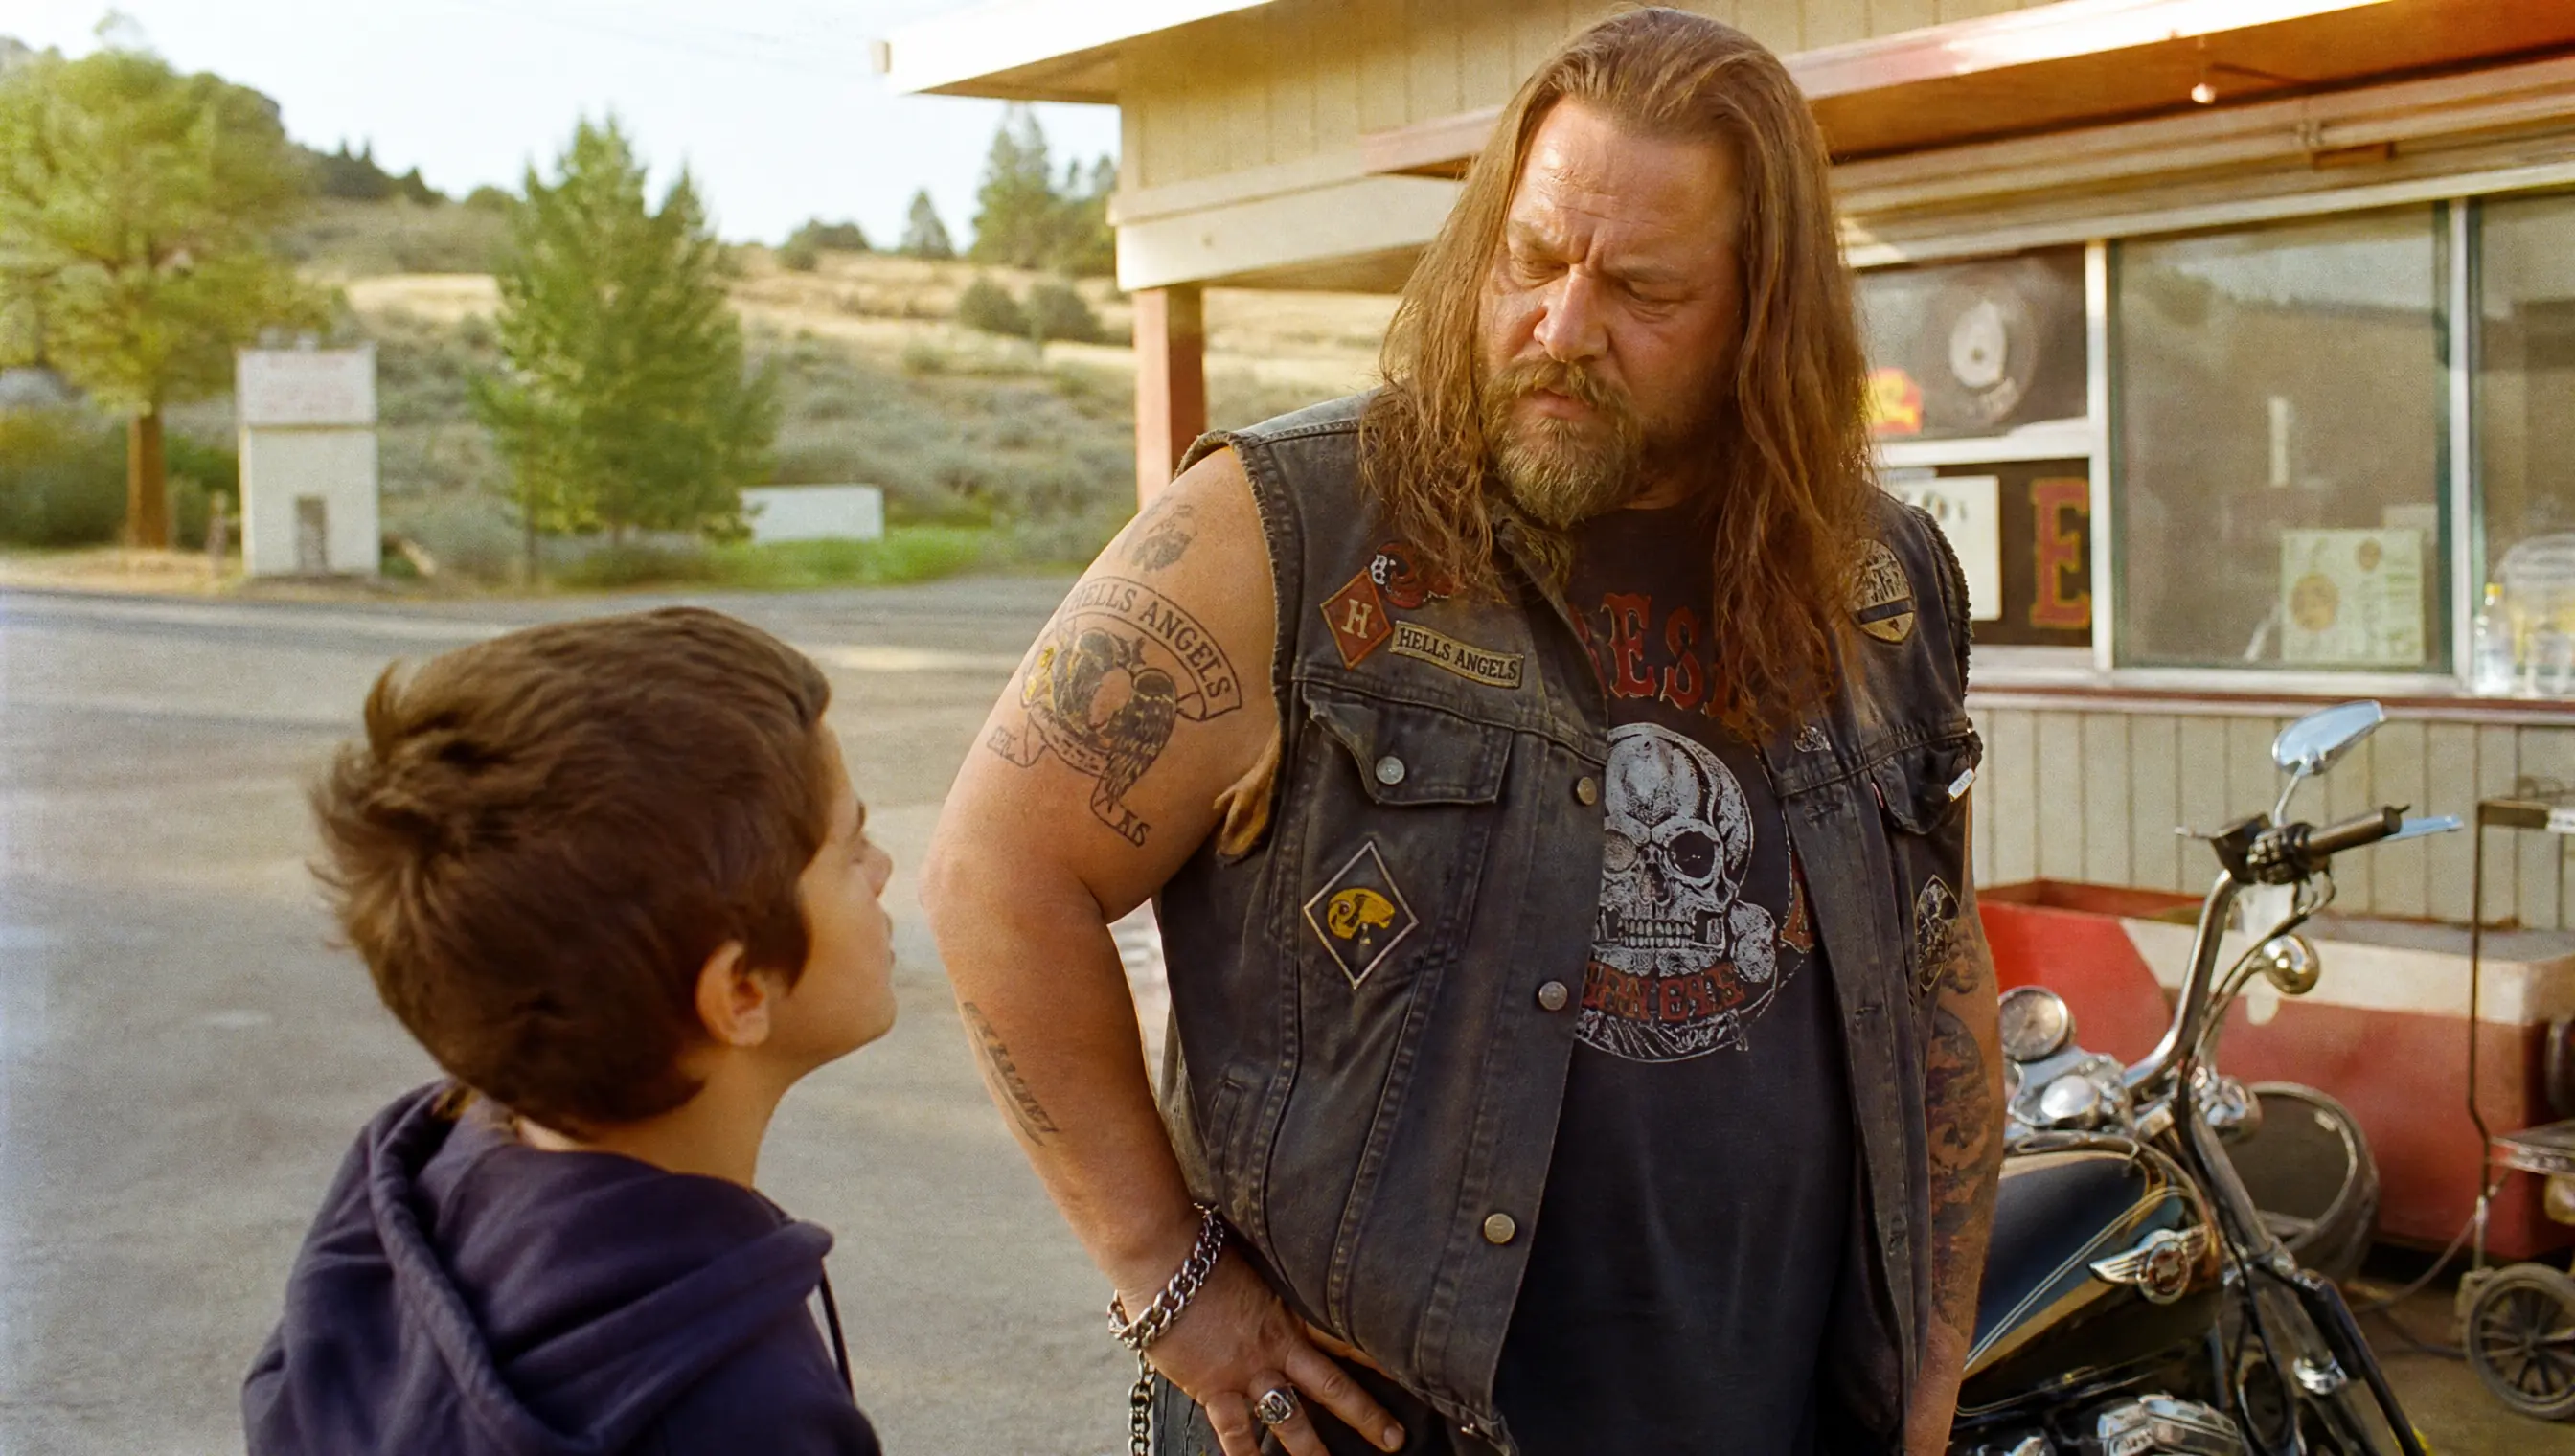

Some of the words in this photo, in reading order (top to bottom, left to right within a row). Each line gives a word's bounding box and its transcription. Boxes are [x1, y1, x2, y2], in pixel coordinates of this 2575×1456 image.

[1068, 583, 1137, 613] HELLS
[1139, 600, 1231, 698] ANGELS
[1341, 599, 1373, 639] H
[1397, 627, 1452, 661] HELLS
[1454, 649, 1517, 681] ANGELS
